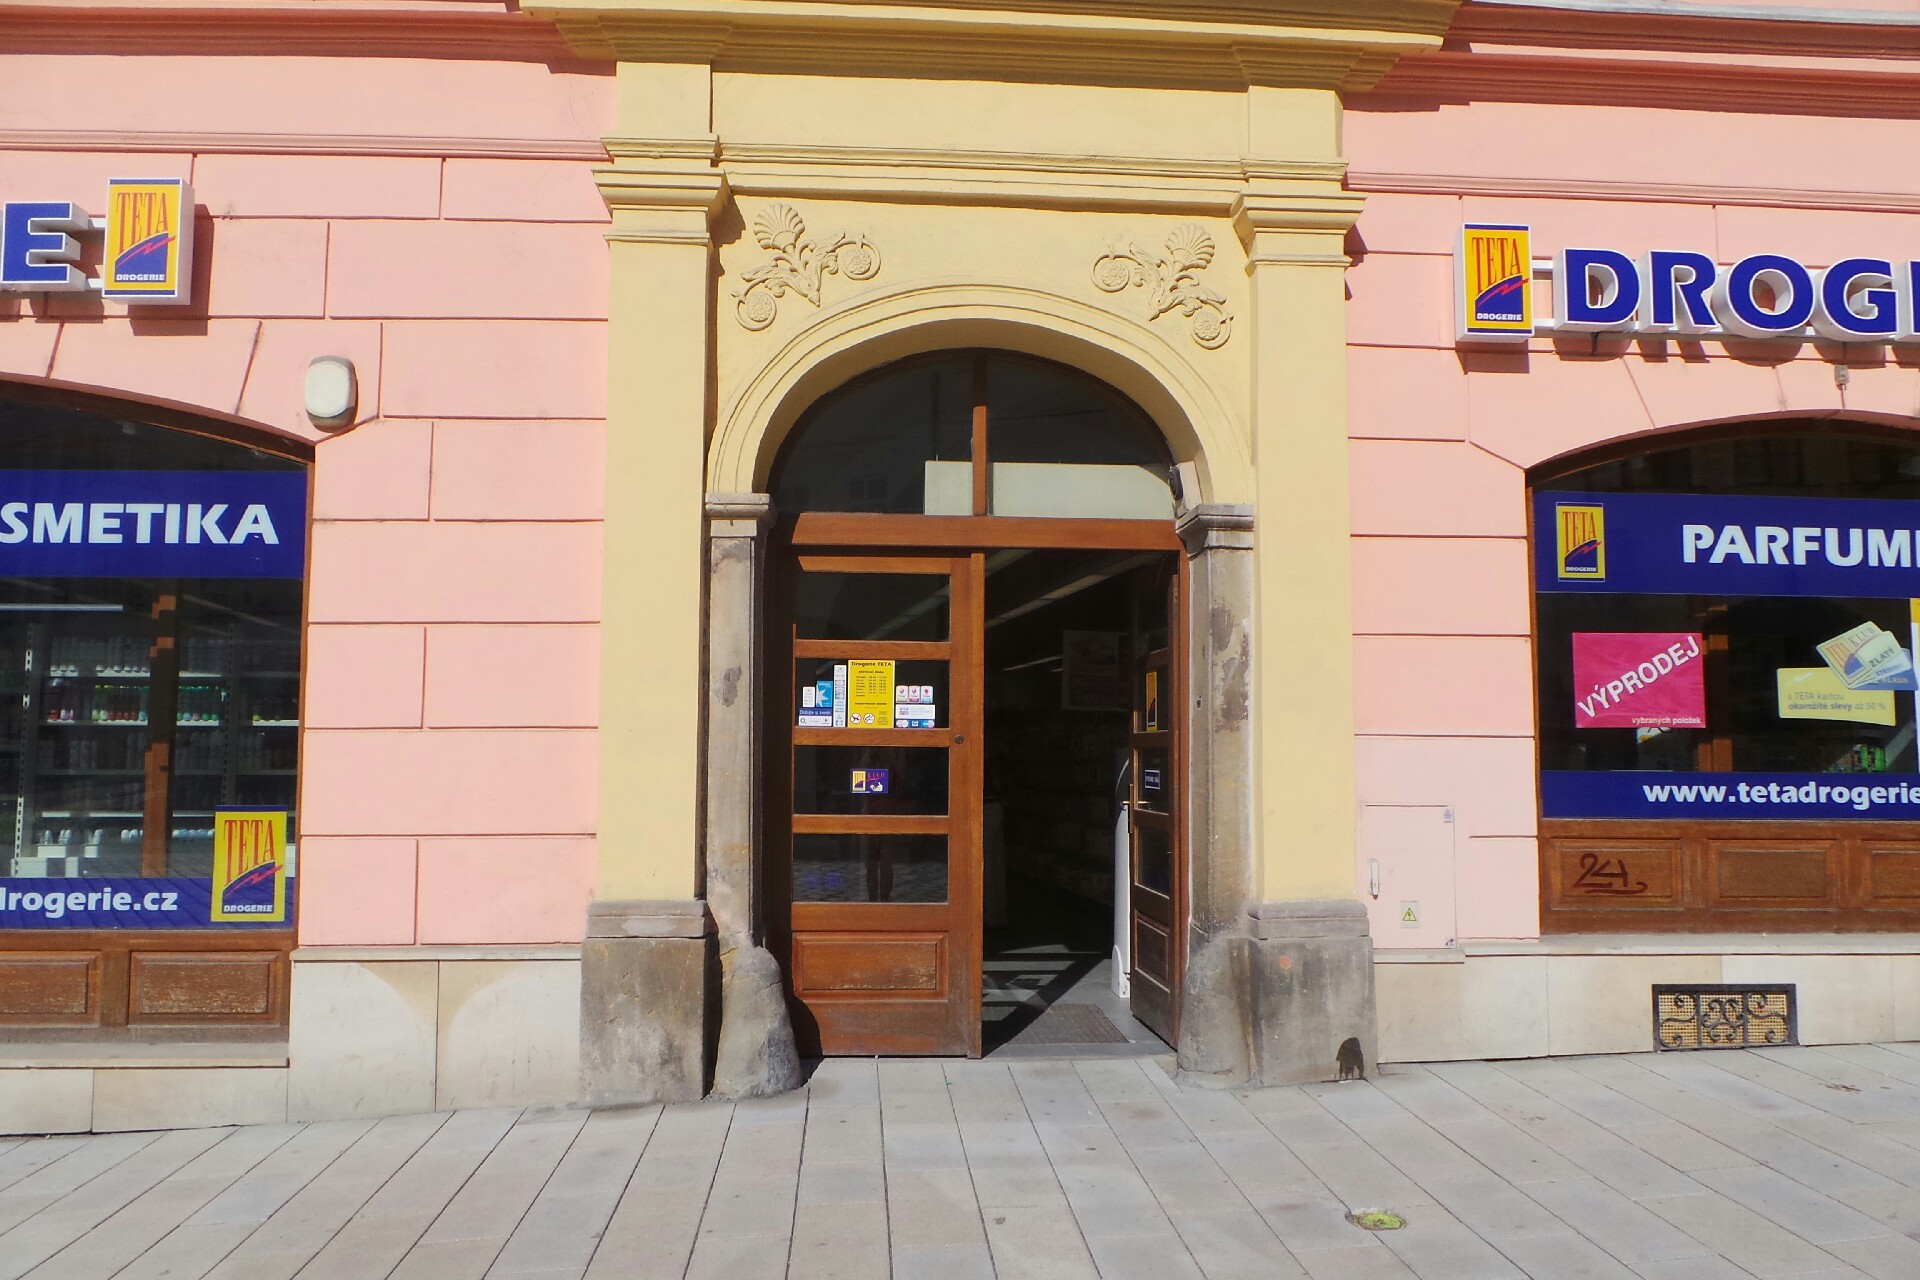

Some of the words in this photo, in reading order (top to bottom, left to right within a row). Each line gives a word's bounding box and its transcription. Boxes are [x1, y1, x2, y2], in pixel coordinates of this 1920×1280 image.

[117, 192, 169, 254] TETA
[115, 273, 166, 281] DROGERIE
[1472, 237, 1522, 294] TETA
[1564, 249, 1920, 335] DROG
[1476, 312, 1522, 321] DROGERIE
[0, 502, 279, 544] SMETIKA
[1562, 511, 1596, 552] TETA
[1682, 524, 1920, 568] PARFUM
[1577, 636, 1700, 718] VÝPRODEJ
[1830, 702, 1852, 711] slevy
[1643, 782, 1920, 810] www.tetadrogerie
[224, 820, 276, 884] TETA
[223, 904, 273, 913] DROGERIE
